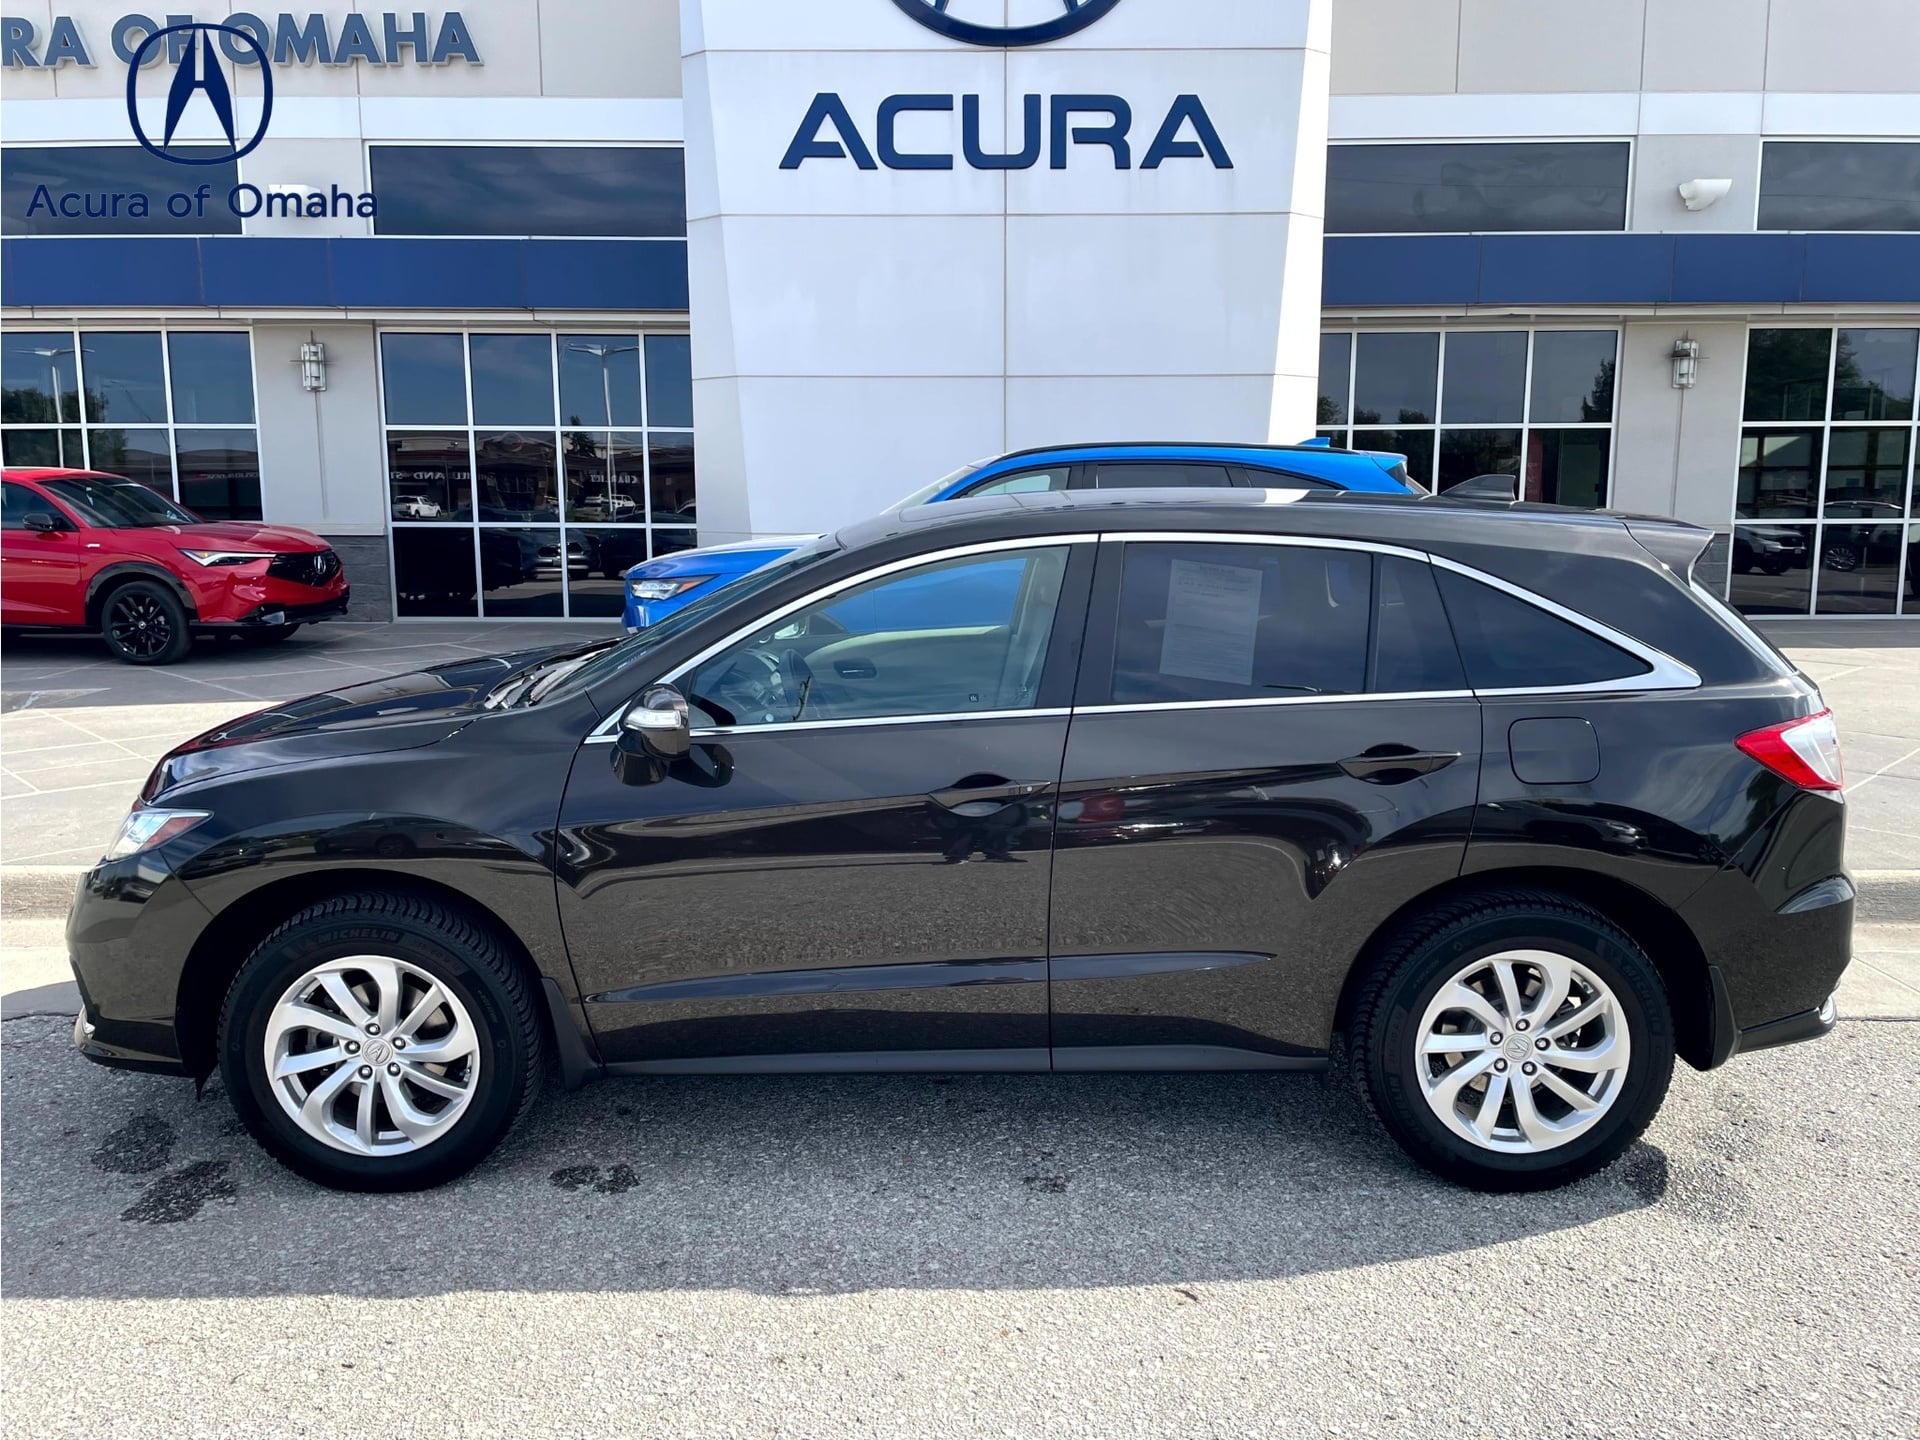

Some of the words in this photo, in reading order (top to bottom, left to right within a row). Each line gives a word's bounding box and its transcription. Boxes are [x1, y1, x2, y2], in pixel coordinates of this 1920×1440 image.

[0, 16, 94, 68] RA
[111, 13, 195, 67] OF
[217, 11, 484, 67] OMAHA
[778, 92, 1235, 170] ACURA
[317, 928, 400, 943] MICHELIN
